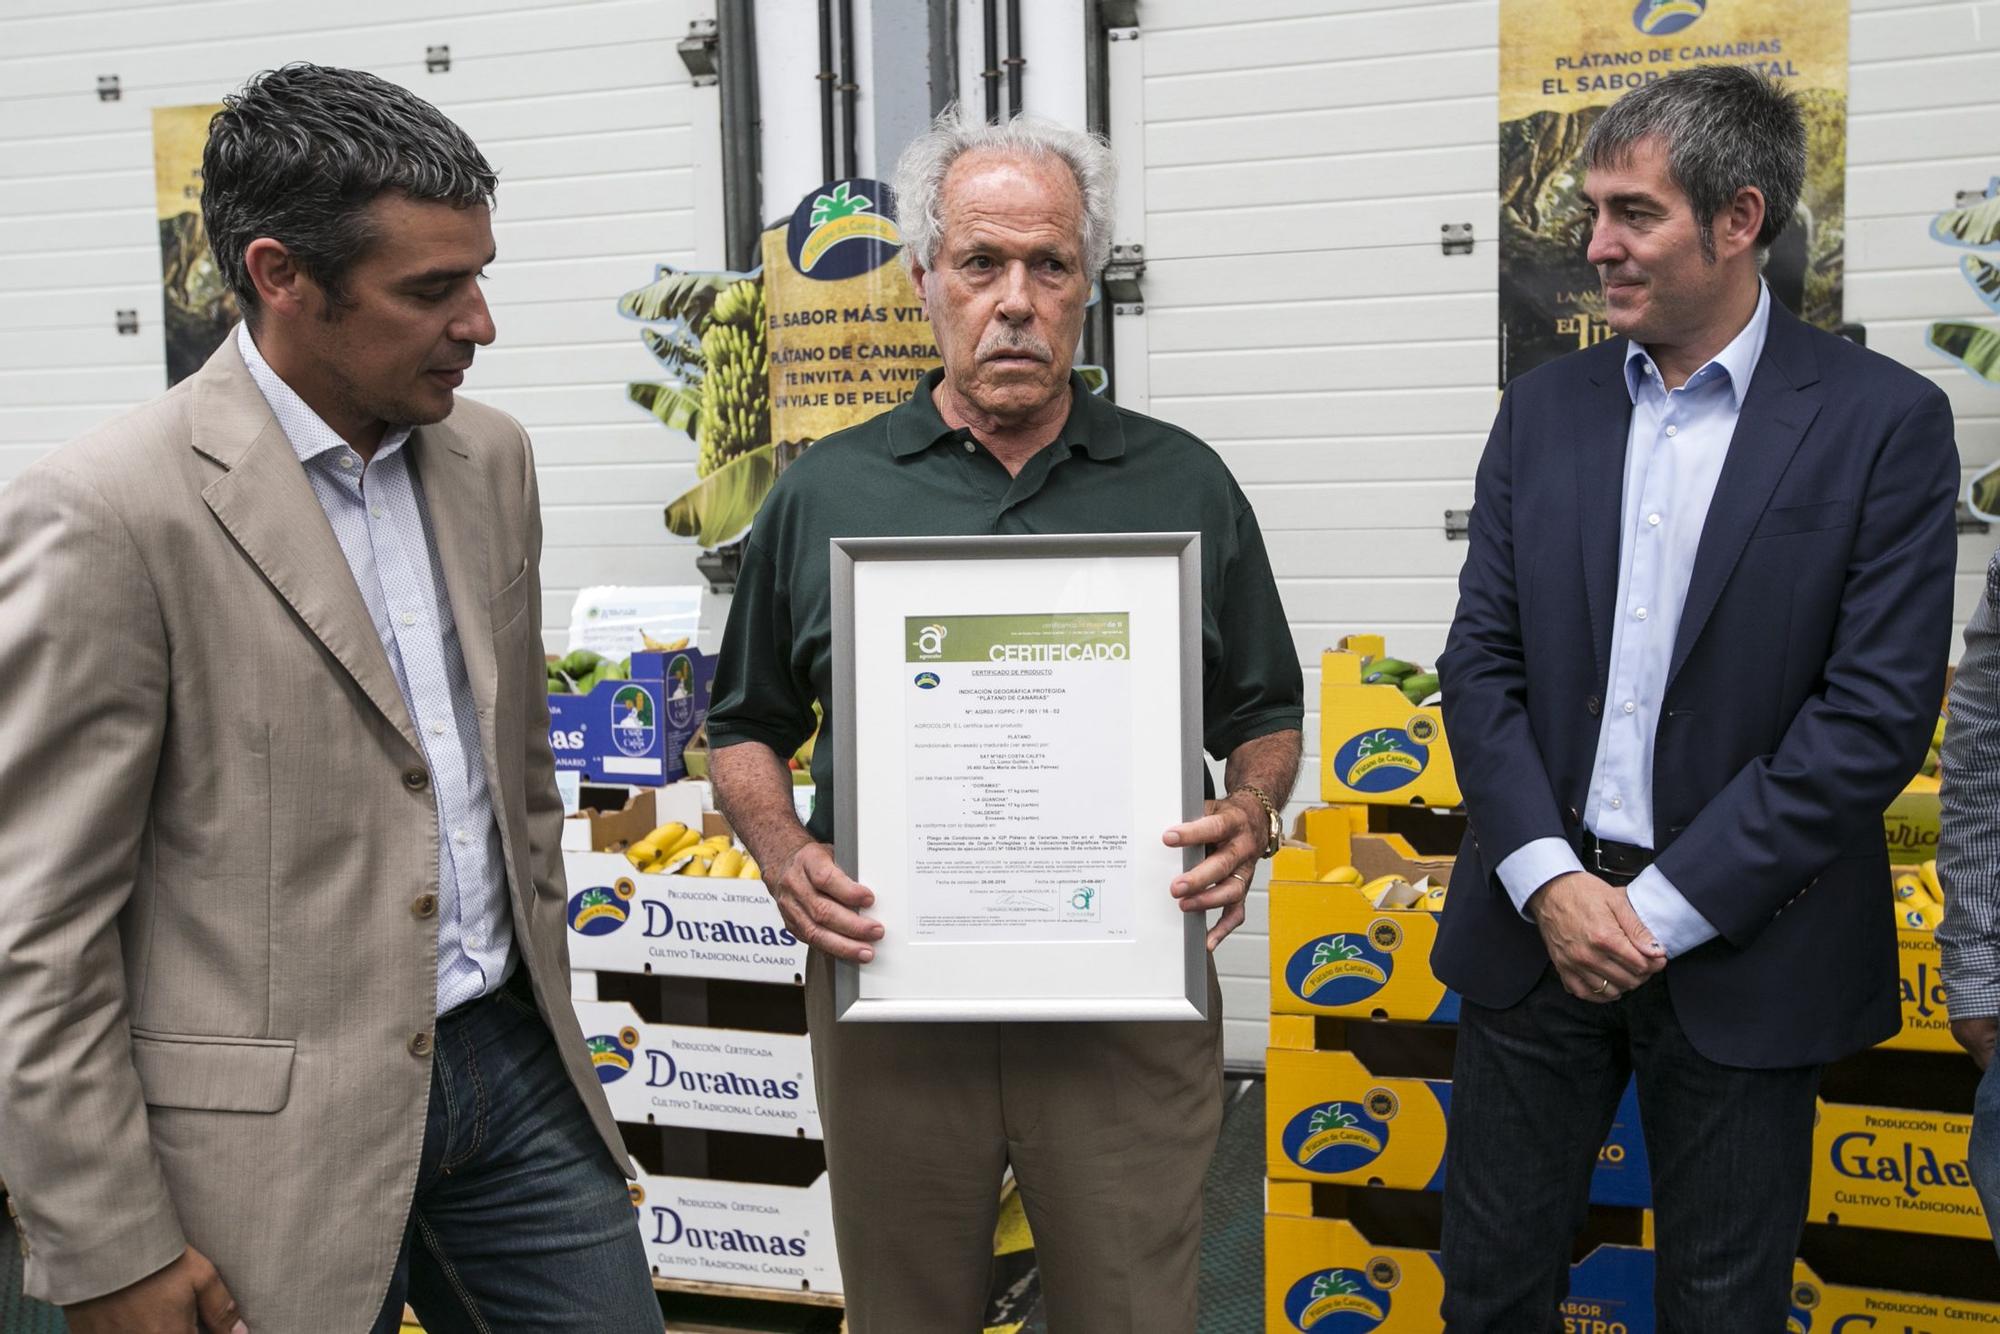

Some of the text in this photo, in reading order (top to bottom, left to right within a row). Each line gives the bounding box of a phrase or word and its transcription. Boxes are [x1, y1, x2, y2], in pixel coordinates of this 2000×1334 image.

[1556, 39, 1781, 70] PLÁTANO DE CANARIAS
[1542, 78, 1568, 94] EL
[1556, 291, 1577, 303] LA
[770, 304, 930, 330] EL SABOR MÁS VIT
[1556, 318, 1579, 334] EL
[772, 344, 942, 364] PLÁTANO DE CANARIA
[786, 372, 798, 386] TE
[801, 369, 854, 384] INVITA
[860, 369, 872, 382] A
[775, 395, 788, 408] UN
[790, 394, 828, 408] VIAJE
[835, 392, 858, 406] DE
[989, 643, 1126, 662] CERTIFICADO
[548, 730, 584, 750] as
[668, 889, 770, 904] PRODUCCIÓN CERTIFICADA
[641, 899, 798, 946] Doramas
[648, 946, 796, 966] CULTIVO TRADICIONAL CANARIO
[672, 1039, 773, 1058] PRODUCCIÓN CERTIFICADA
[646, 1048, 800, 1100] Doramas
[651, 1096, 798, 1120] CULTIVO TRADICIONAL CANARIO
[1865, 1115, 1937, 1132] PRODUCCIÓN
[1830, 1131, 1970, 1198] Galde
[678, 1196, 780, 1214] PRODUCCIÓN CERTIFICADA
[1835, 1190, 1982, 1216] CULTIVO TRADICIONAL
[651, 1206, 806, 1257] Doramas
[658, 1252, 697, 1266] CULTIVO
[699, 1256, 759, 1273] TRADICIONAL
[762, 1262, 805, 1276] CANARIO
[1865, 1297, 1938, 1316] PRODUCCIÓN
